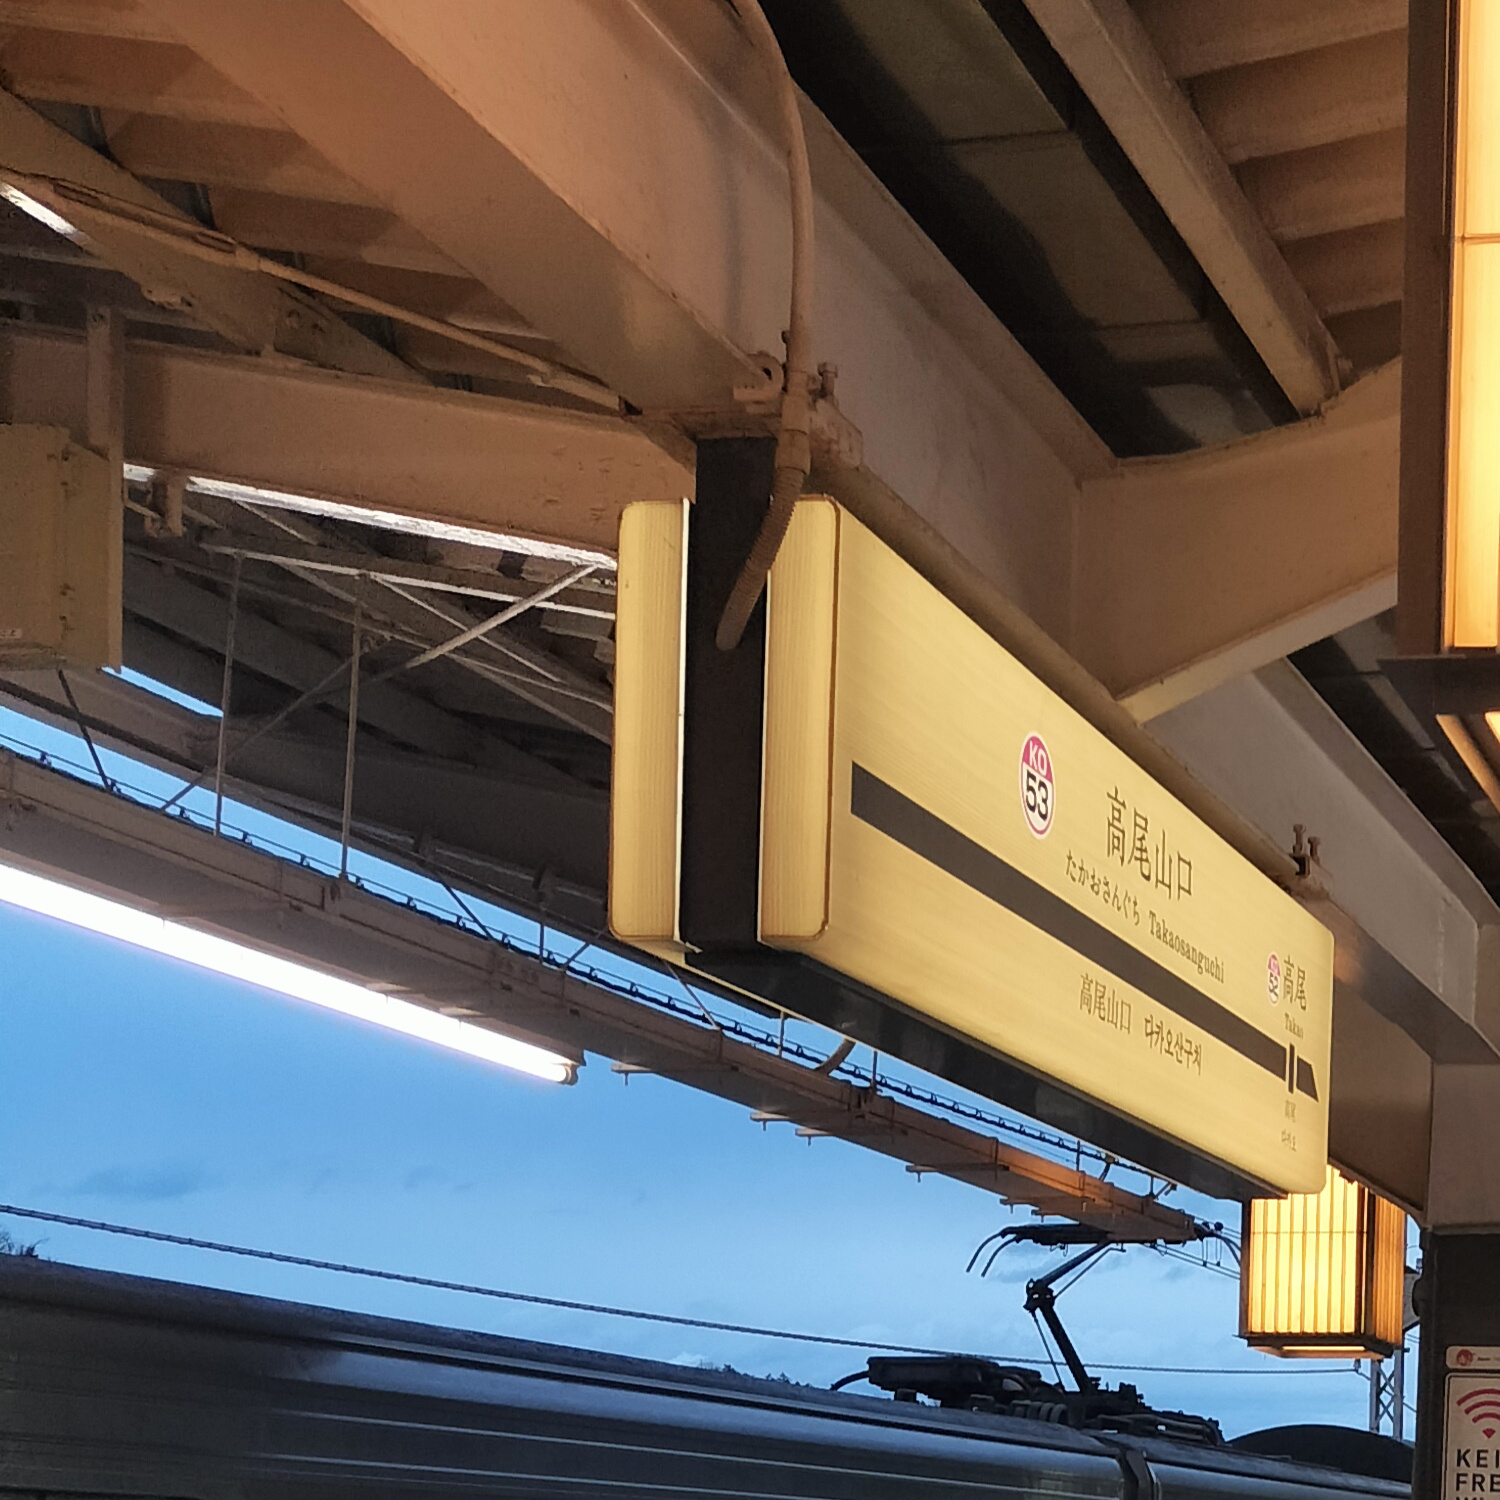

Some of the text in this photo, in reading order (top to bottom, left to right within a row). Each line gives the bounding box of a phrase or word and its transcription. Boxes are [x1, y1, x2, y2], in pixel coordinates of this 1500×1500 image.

[1025, 769, 1049, 821] 53
[1029, 740, 1048, 777] KO
[1106, 785, 1193, 901] 高尾山口
[1065, 849, 1225, 984] たかおさんぐち Takaosanguchi
[1283, 953, 1307, 1012] 高尾
[1079, 972, 1203, 1077] 高尾山口 다카오산구치
